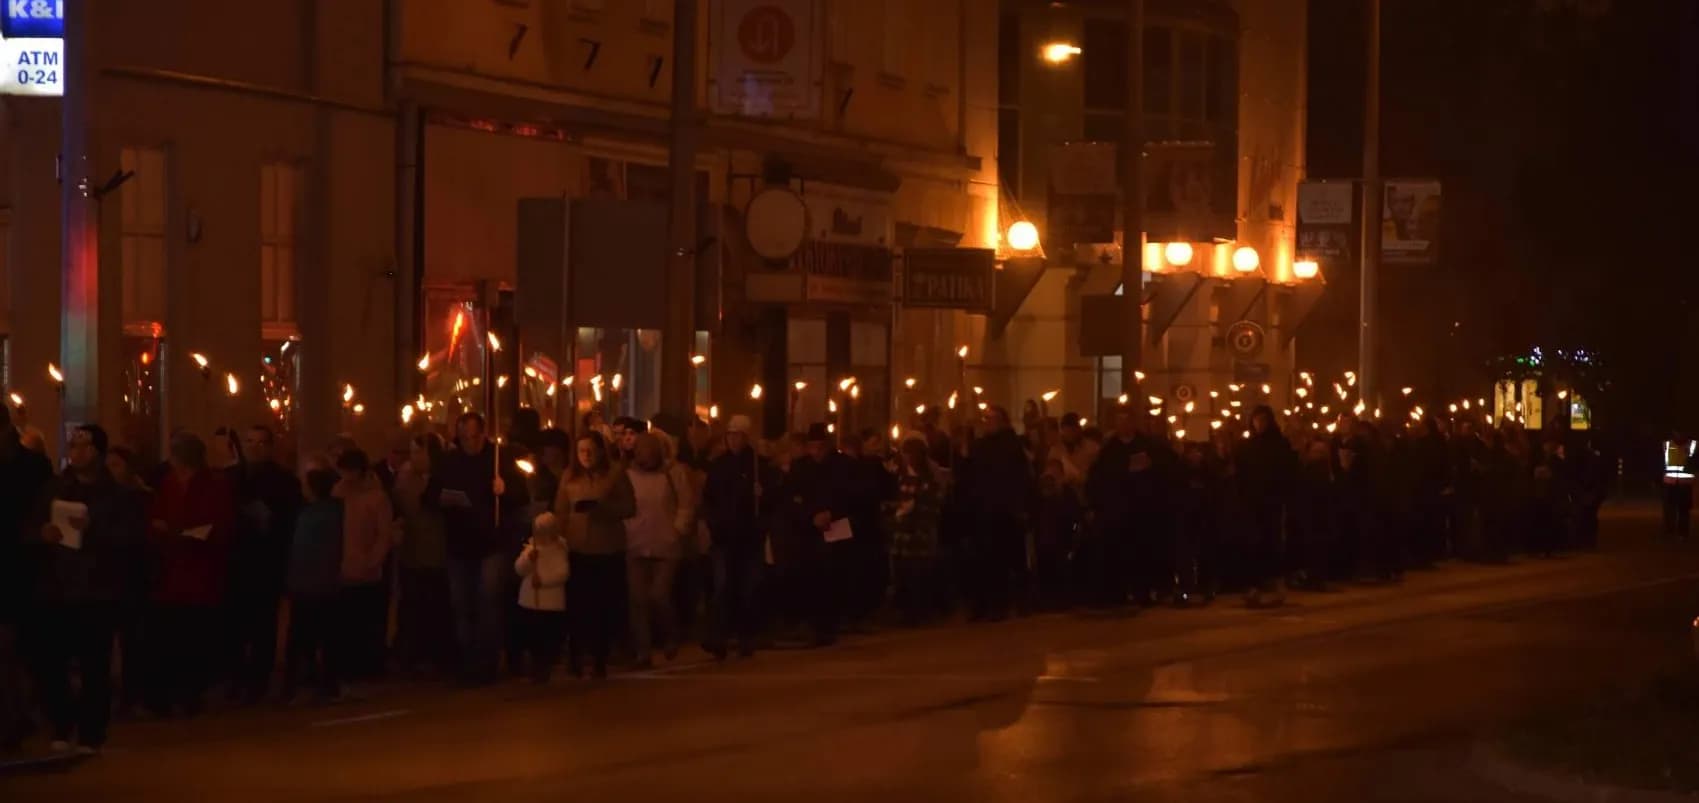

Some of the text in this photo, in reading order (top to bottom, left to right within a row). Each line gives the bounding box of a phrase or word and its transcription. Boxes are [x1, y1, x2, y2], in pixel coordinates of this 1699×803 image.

[18, 51, 58, 65] ATM
[18, 70, 57, 84] 0-24
[927, 273, 985, 299] PATIKA
